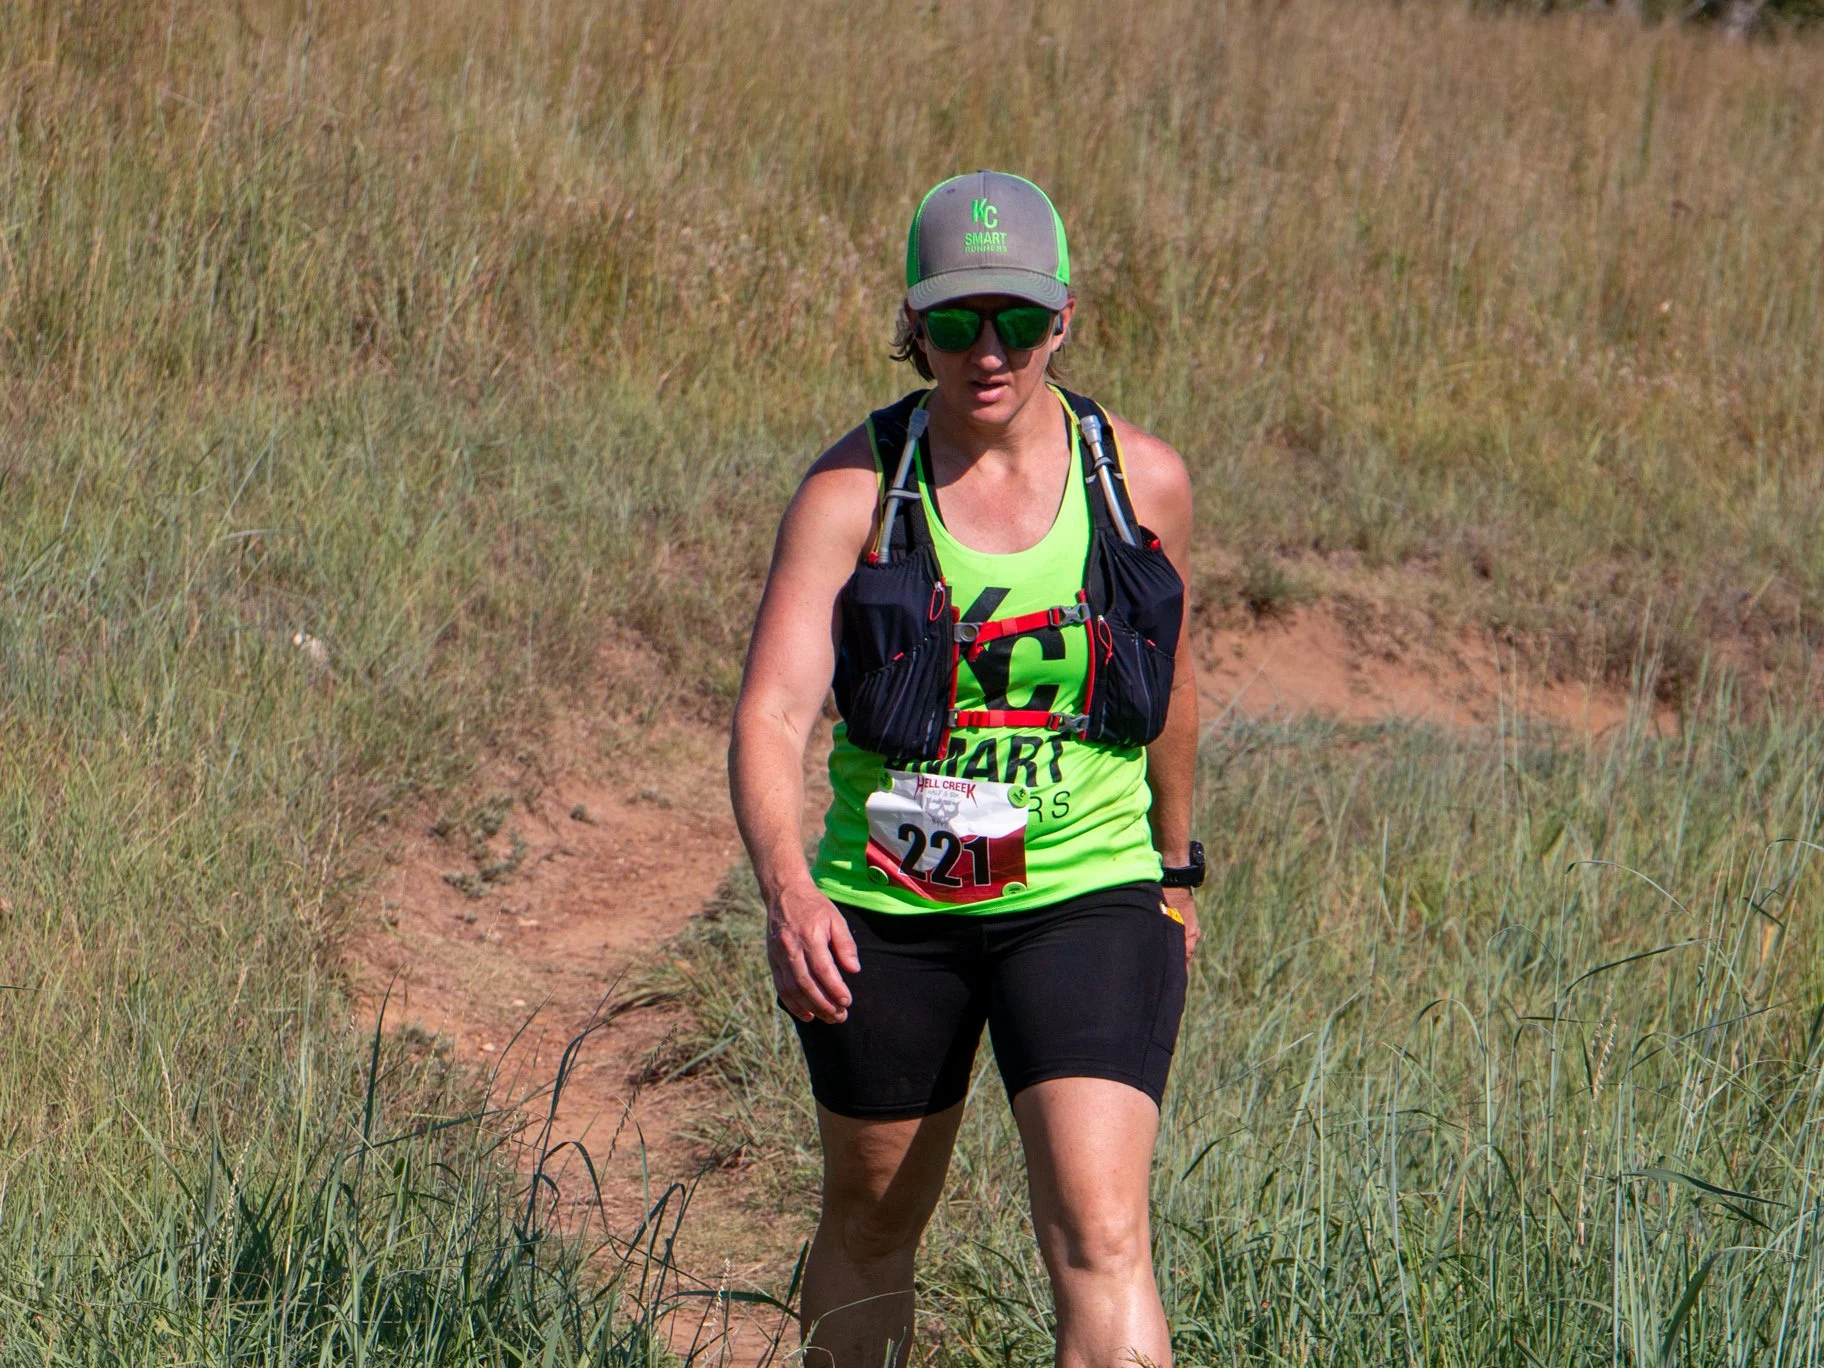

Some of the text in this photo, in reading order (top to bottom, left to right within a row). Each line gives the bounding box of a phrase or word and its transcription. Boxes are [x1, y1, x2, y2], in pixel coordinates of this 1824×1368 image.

[971, 198, 998, 229] KC
[964, 231, 1007, 246] SMART
[913, 774, 940, 800] HELL
[942, 780, 979, 809] CREEK
[897, 822, 992, 888] 221
